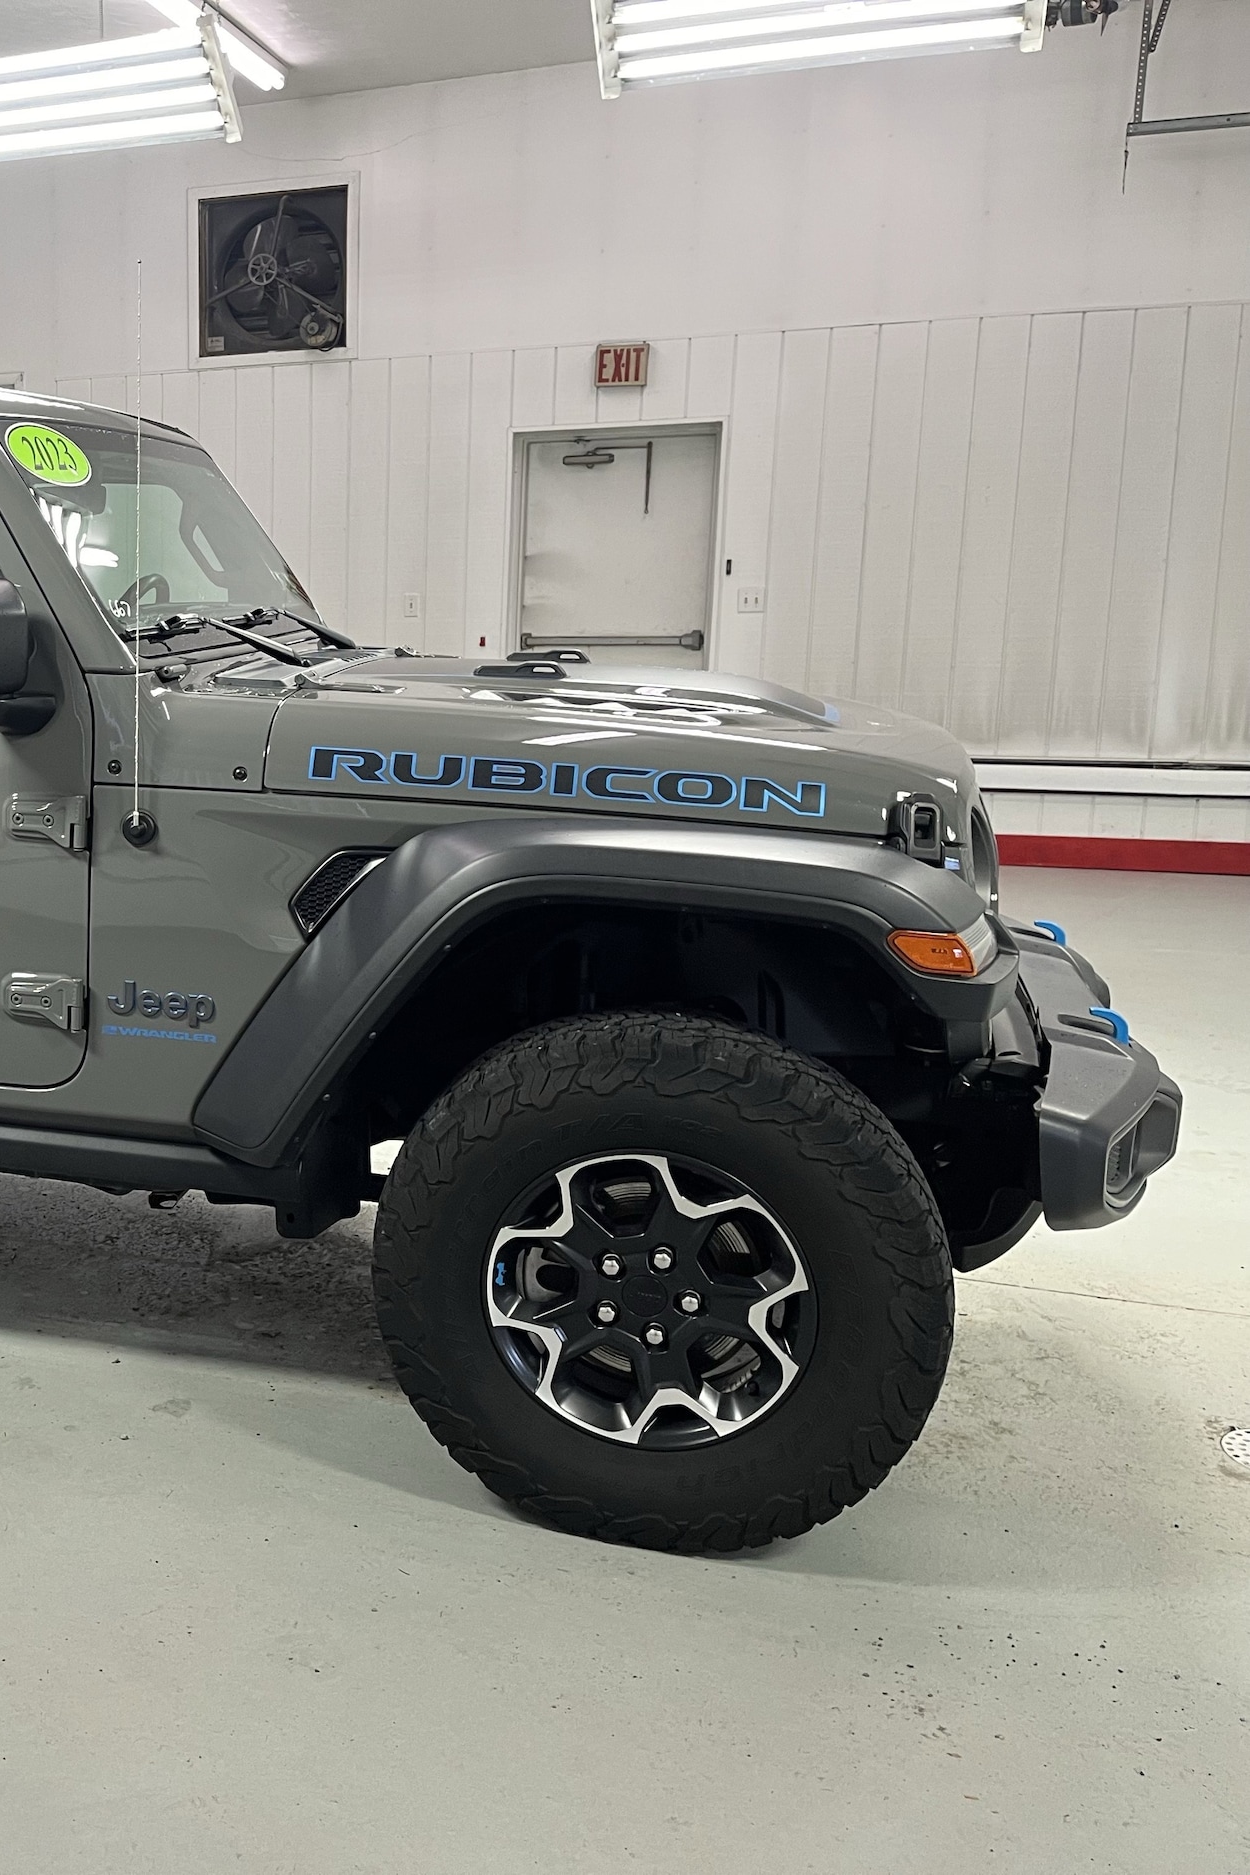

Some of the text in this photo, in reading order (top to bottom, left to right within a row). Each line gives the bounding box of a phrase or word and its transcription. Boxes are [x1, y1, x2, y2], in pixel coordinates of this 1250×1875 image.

[598, 347, 644, 383] EXIT
[21, 436, 77, 470] 2023
[308, 745, 827, 816] RUBICON
[107, 979, 214, 1028] Jeep
